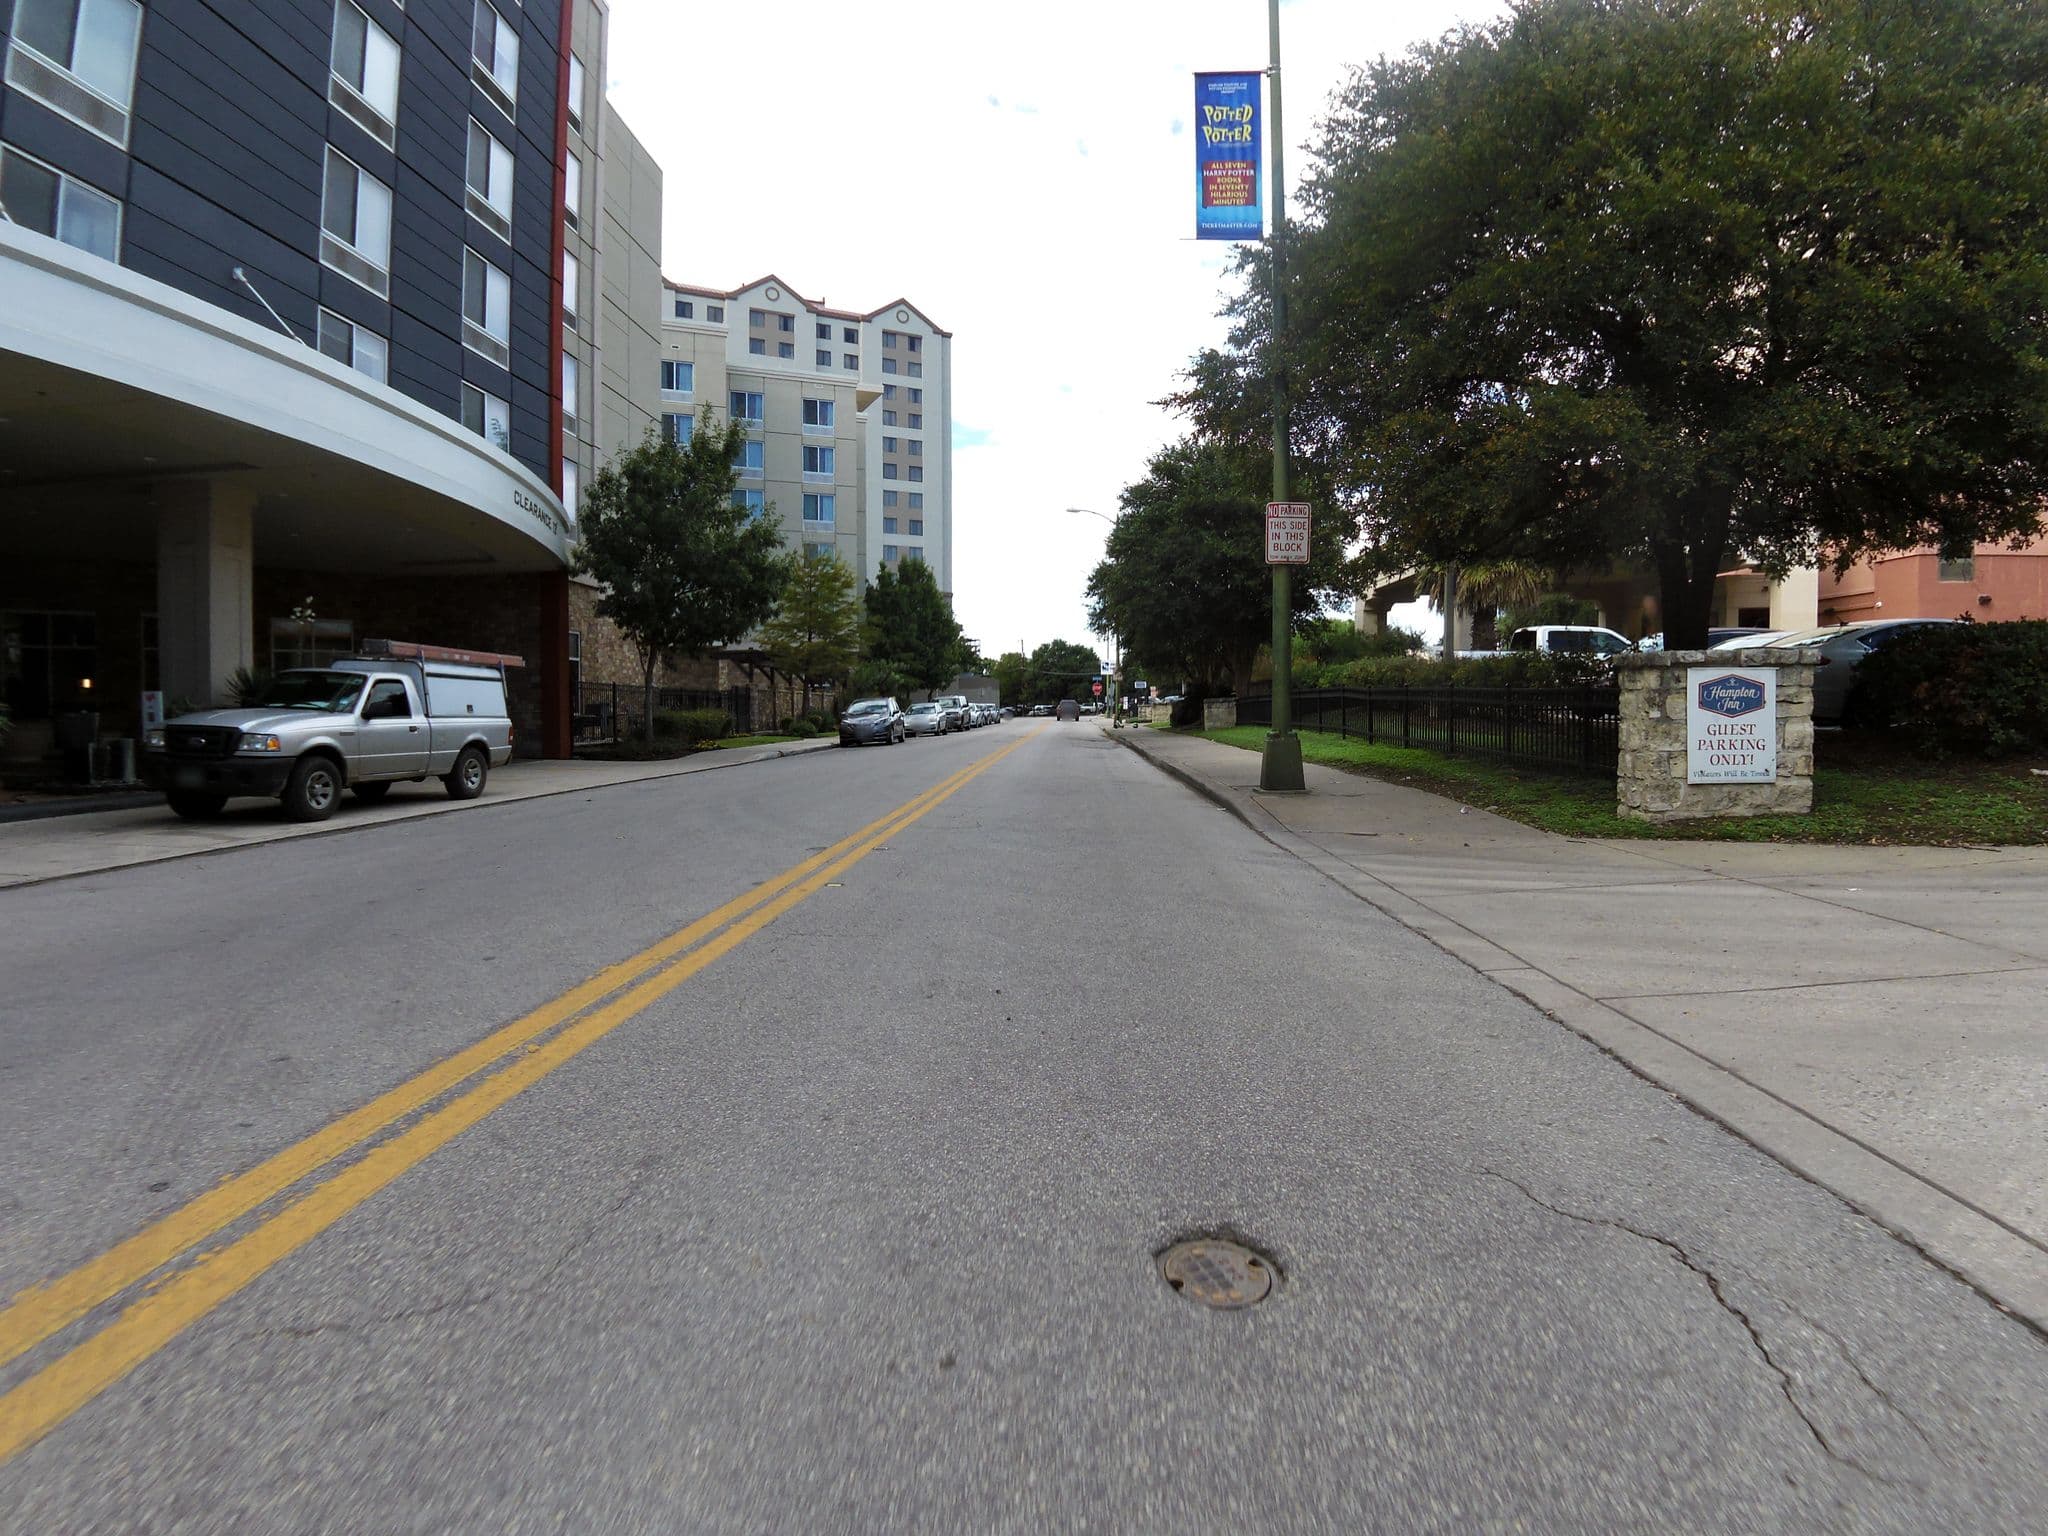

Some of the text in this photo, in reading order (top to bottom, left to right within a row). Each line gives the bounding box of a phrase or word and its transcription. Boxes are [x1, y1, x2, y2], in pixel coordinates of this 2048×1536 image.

[1203, 104, 1252, 125] POTTED
[1202, 124, 1252, 148] POTTER
[514, 490, 551, 530] CLEARANCE
[1280, 506, 1307, 516] PARKING
[1270, 521, 1307, 530] THIS SIDE
[1271, 532, 1304, 540] IN THIS
[1273, 543, 1302, 551] BLOCK
[1704, 686, 1760, 700] Hampton
[1718, 698, 1745, 711] Inn
[1707, 724, 1756, 736] GUEST
[1697, 739, 1766, 751] PARKING
[1709, 754, 1754, 766] ONLY!
